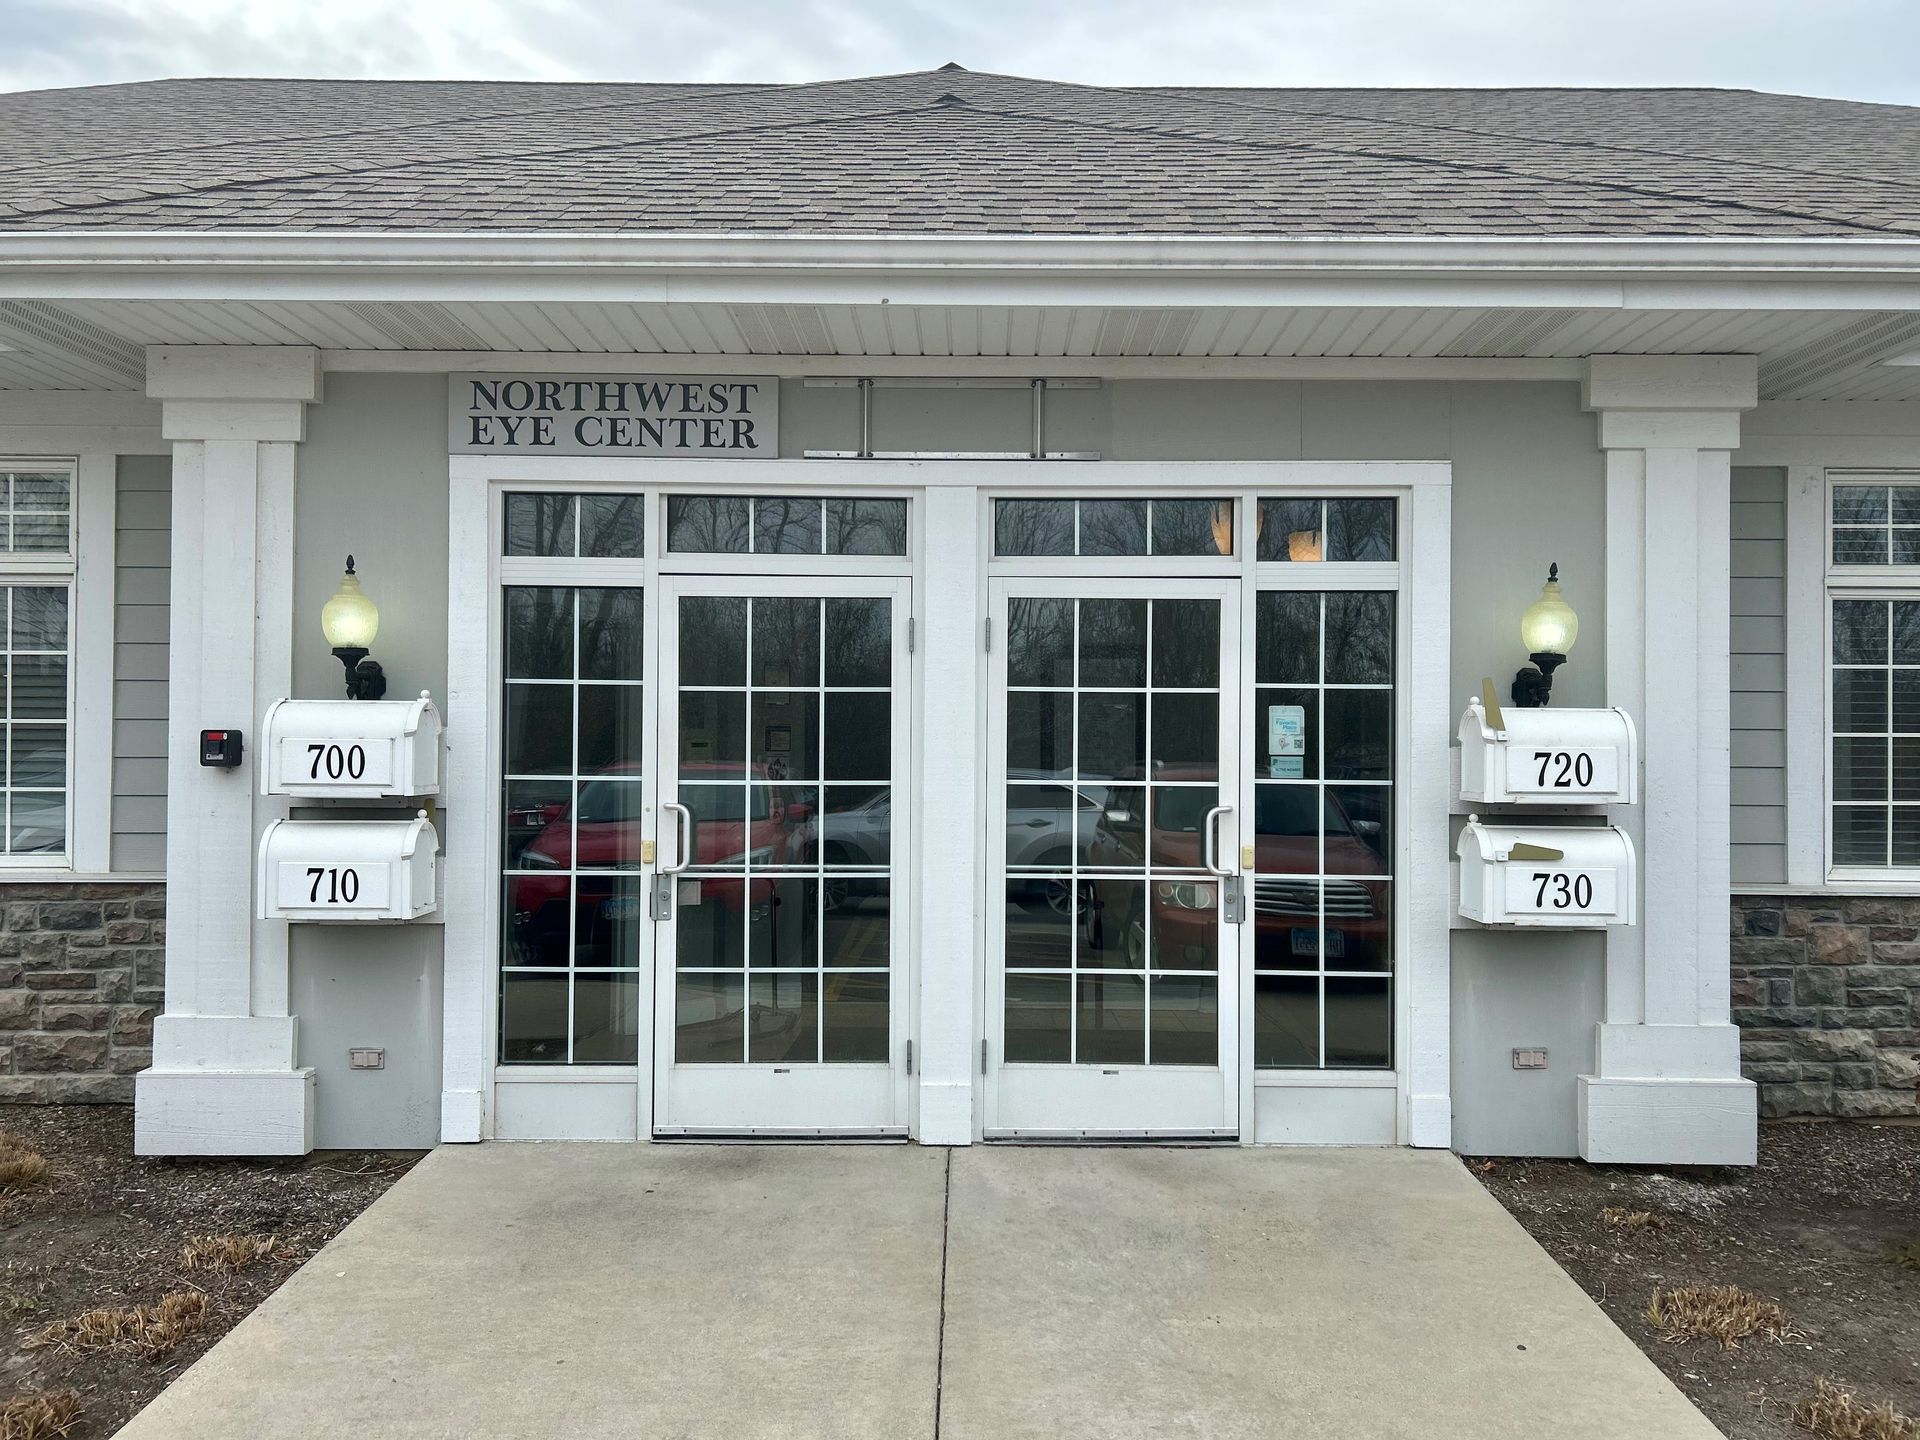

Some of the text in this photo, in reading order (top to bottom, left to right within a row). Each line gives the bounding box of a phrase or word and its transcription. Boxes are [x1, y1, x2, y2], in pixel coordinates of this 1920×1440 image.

[469, 380, 758, 414] NORTHWEST
[468, 416, 759, 449] EYE CENTER
[307, 744, 366, 779] 700
[1533, 752, 1594, 787] 720
[306, 868, 359, 903] 710
[1532, 873, 1593, 909] 730
